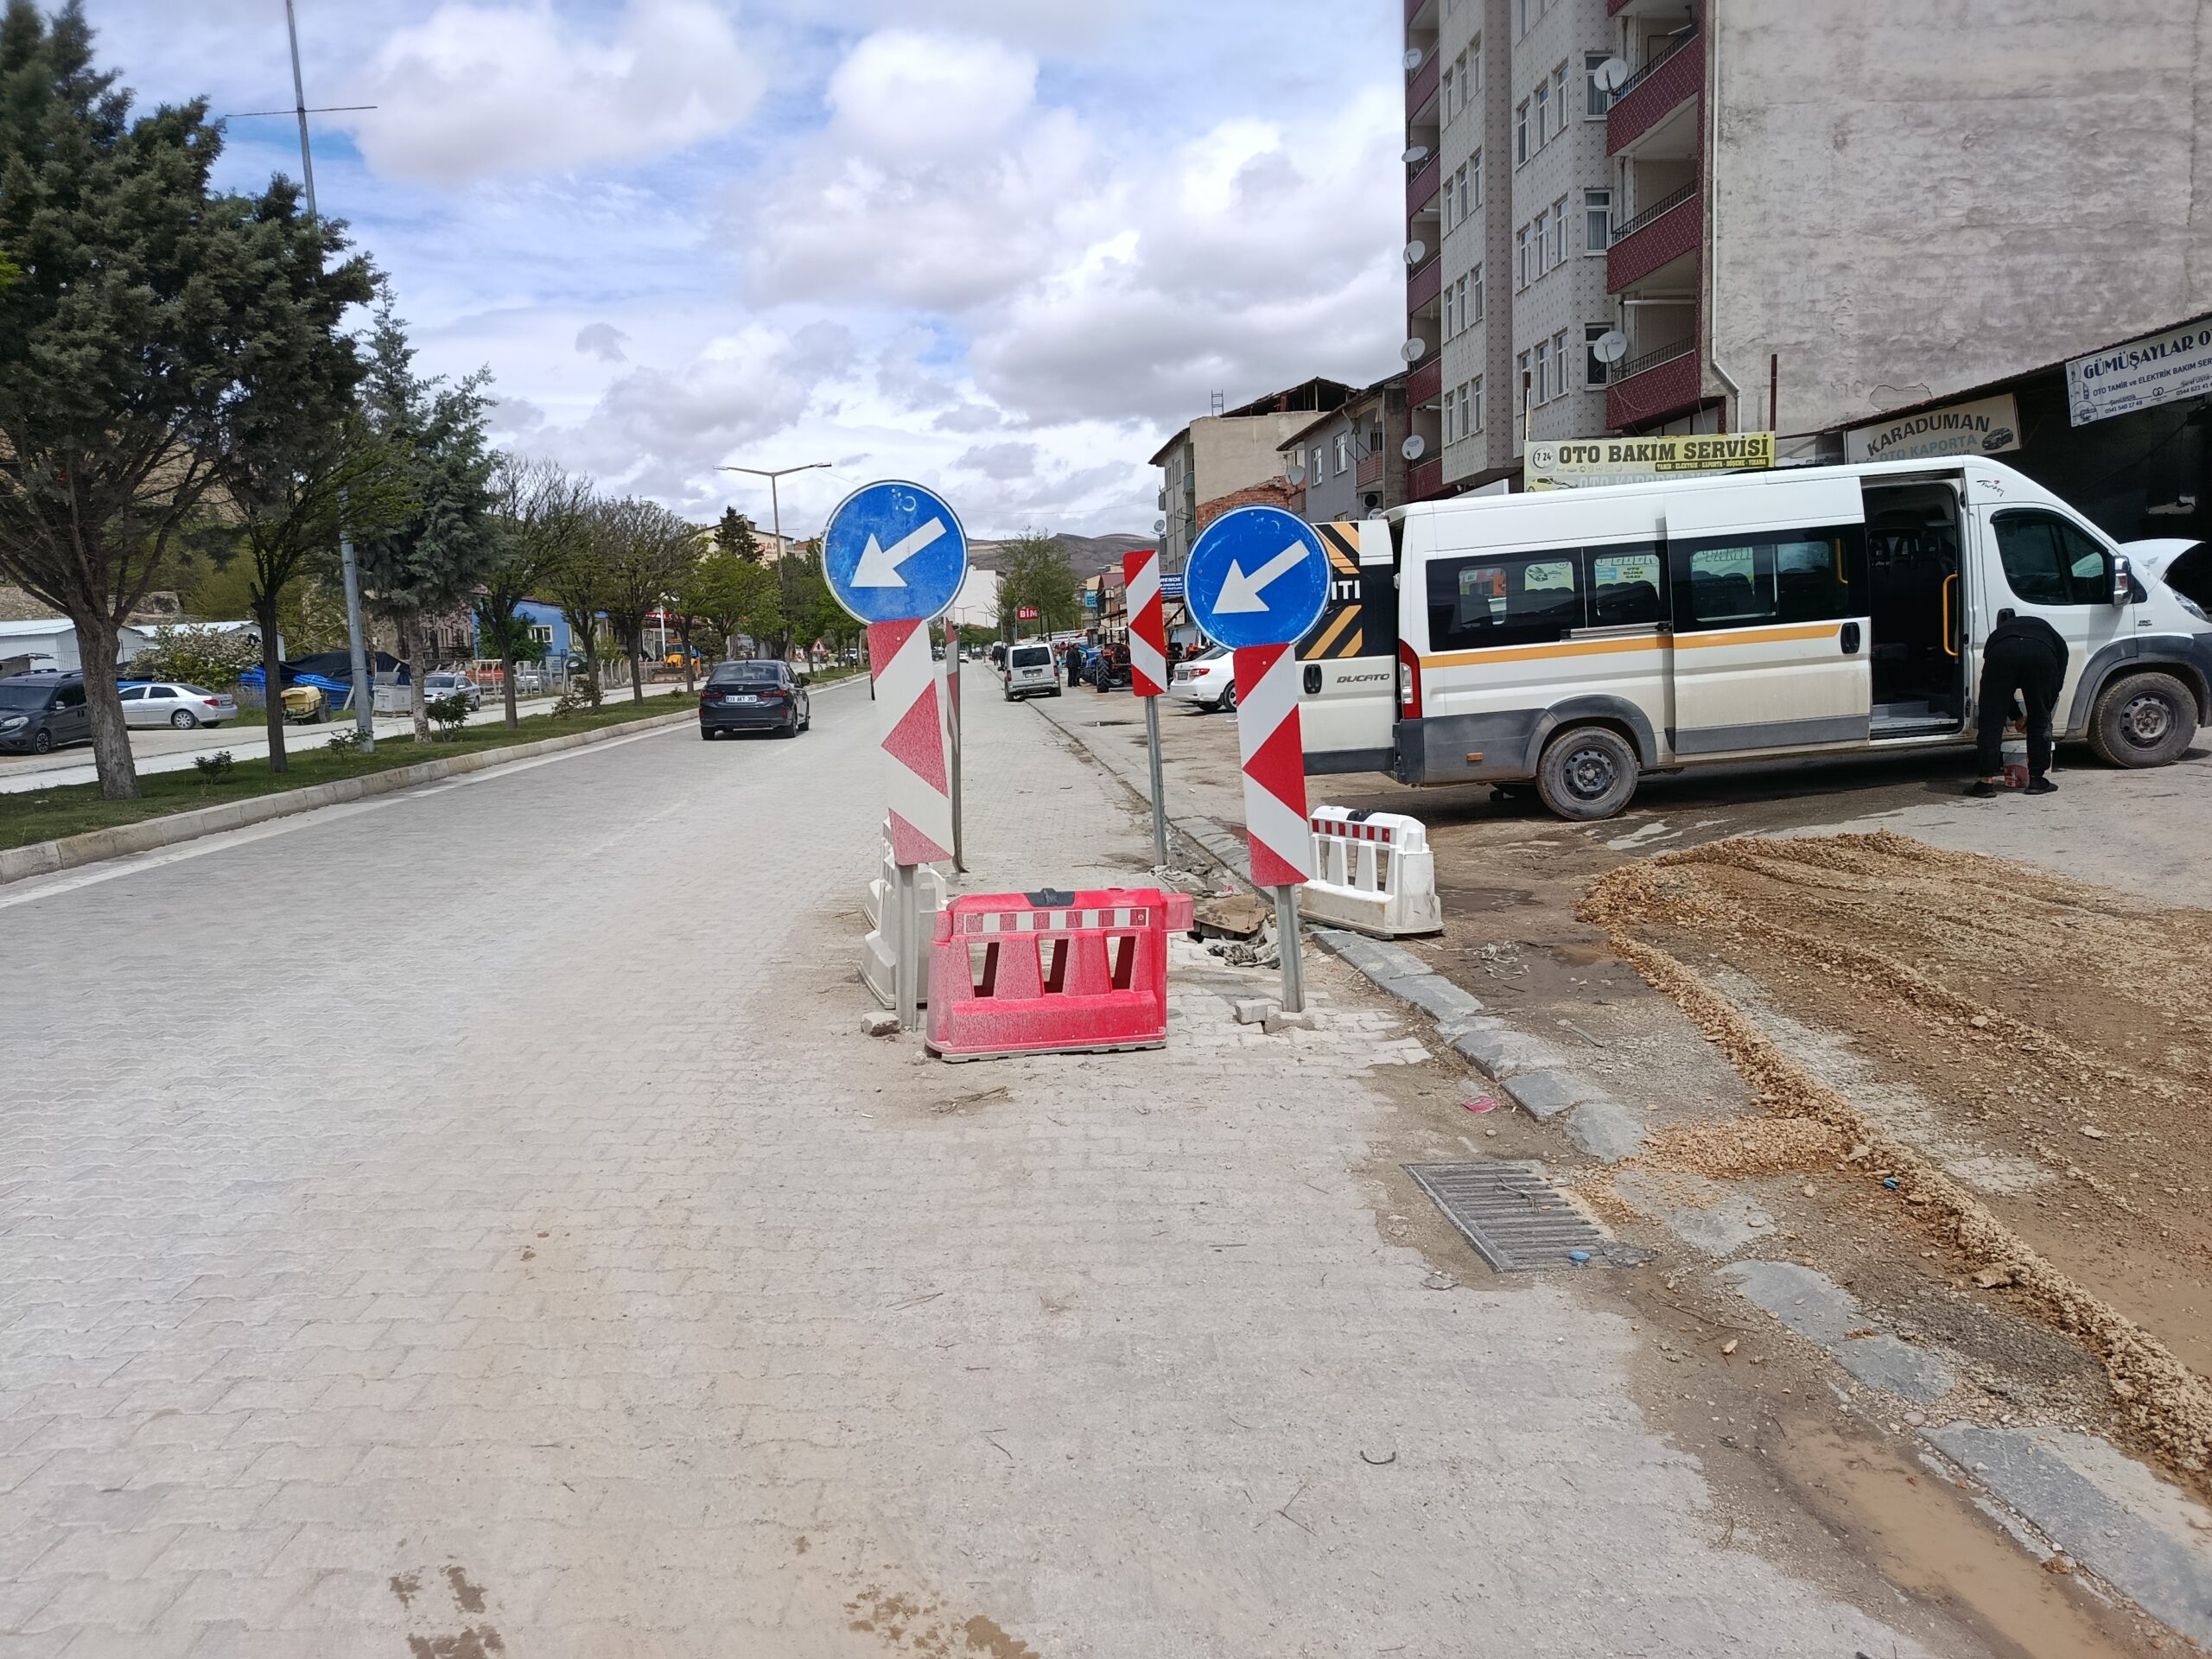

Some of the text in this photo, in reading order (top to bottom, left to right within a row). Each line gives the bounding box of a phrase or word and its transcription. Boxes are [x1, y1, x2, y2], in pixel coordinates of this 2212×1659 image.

[2084, 328, 2212, 379] GÜMÜŞAYLAR O
[2093, 388, 2107, 397] OTO
[2107, 381, 2128, 392] TAMİR
[2139, 369, 2171, 384] ELEKTRİK
[2172, 363, 2196, 375] BAKIM
[2198, 358, 2212, 367] SER
[1867, 414, 1991, 456] KARADUMAN
[1879, 448, 1905, 461] OTO
[1910, 434, 1978, 457] KAPORTA
[1542, 452, 1551, 461] 24
[1559, 434, 1769, 464] OTO BAKIM SERVİSİ
[1332, 580, 1361, 601] ITI
[1020, 607, 1038, 618] BİM
[1337, 673, 1390, 683] DUCATO
